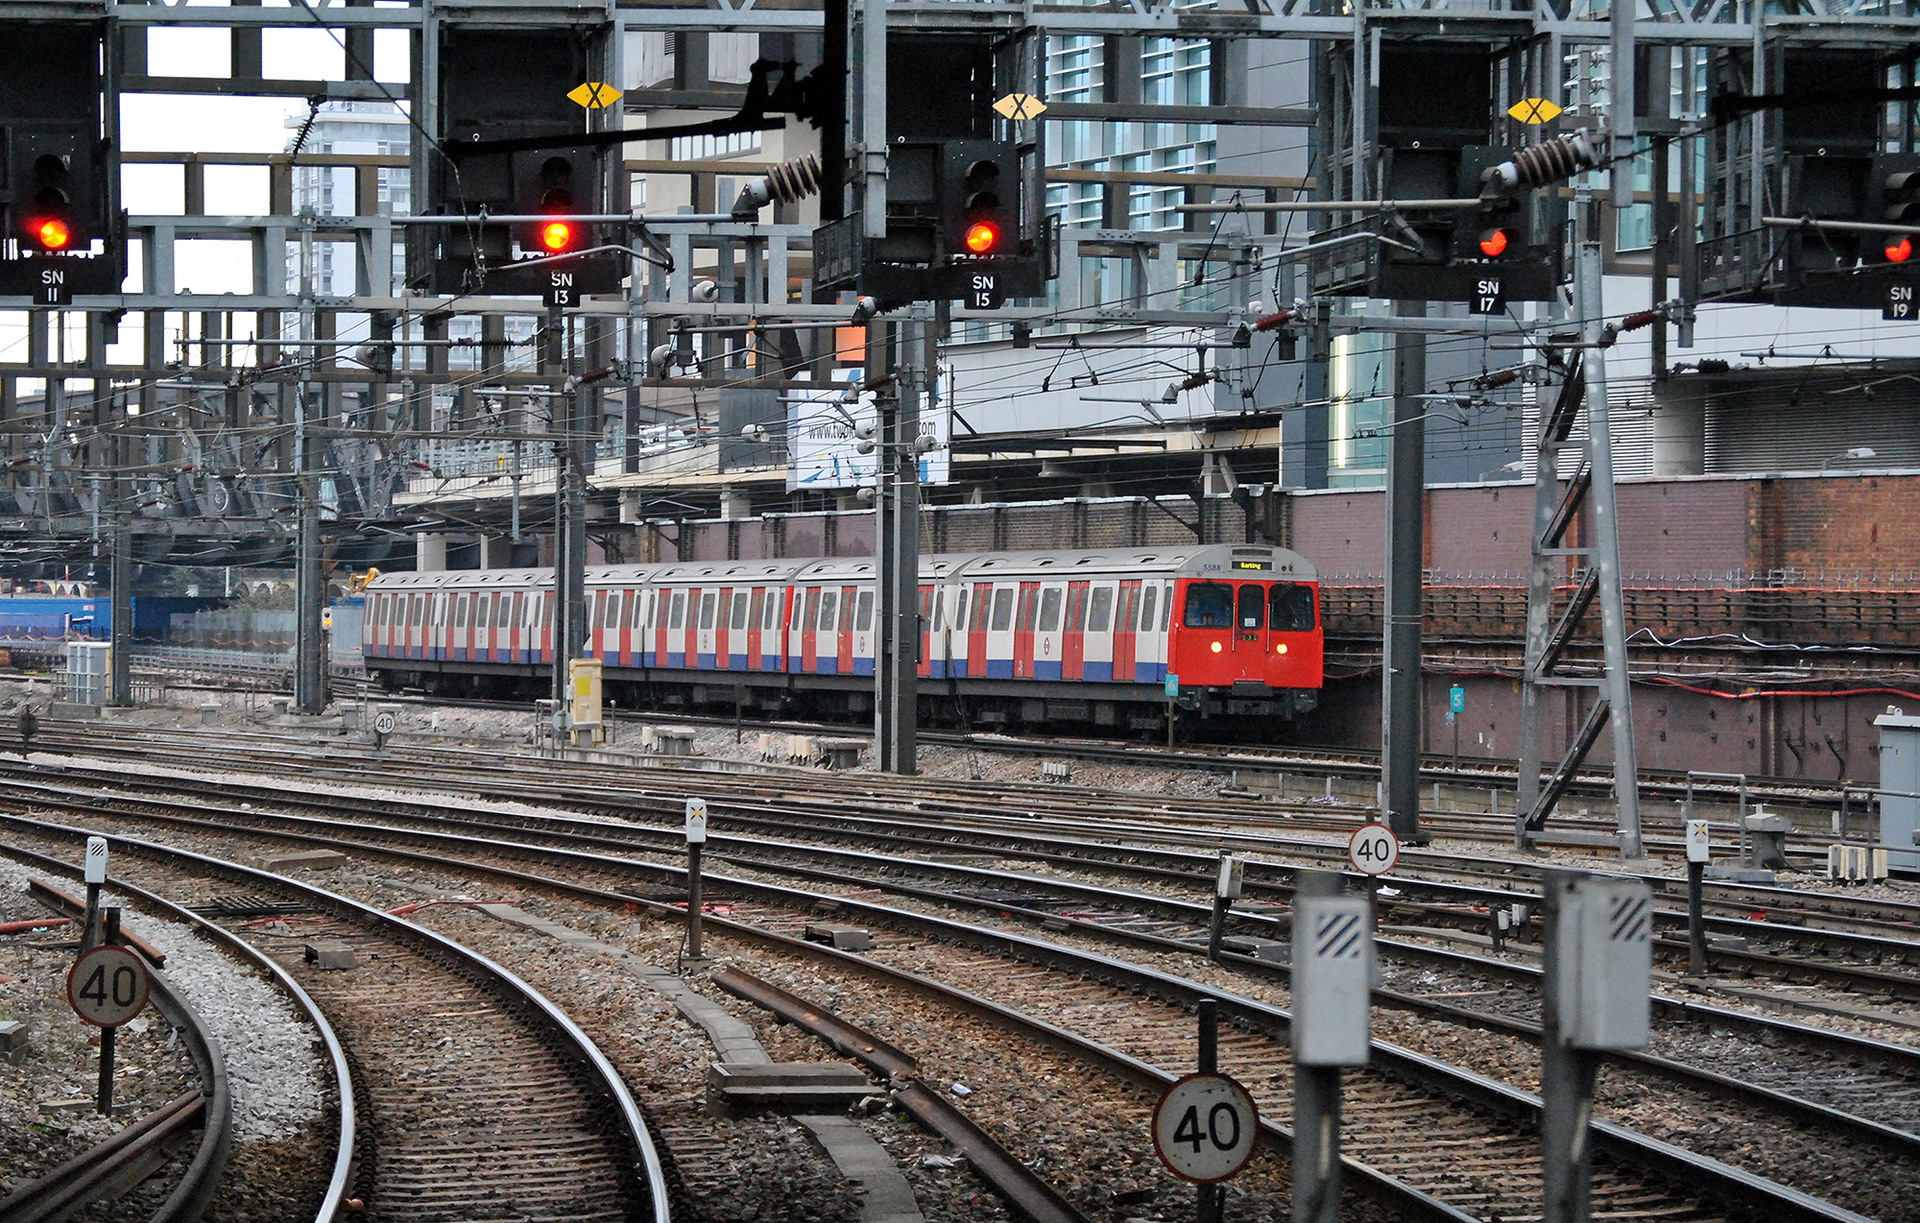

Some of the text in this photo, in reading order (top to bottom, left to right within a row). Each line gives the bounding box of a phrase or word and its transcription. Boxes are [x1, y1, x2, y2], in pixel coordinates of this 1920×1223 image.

[41, 270, 64, 284] SN
[551, 272, 573, 287] SN
[972, 276, 994, 290] SN
[48, 287, 58, 302] 11
[1477, 281, 1499, 295] SN
[1890, 287, 1912, 300] SN
[554, 290, 569, 304] 13
[976, 292, 990, 306] 15
[1480, 297, 1495, 312] 17
[1893, 303, 1908, 317] 19
[1203, 563, 1221, 571] 5588
[1240, 561, 1262, 570] Barking
[1168, 679, 1176, 691] 6
[1453, 694, 1461, 706] 5
[377, 718, 393, 729] 40
[1357, 838, 1389, 861] 40
[79, 964, 136, 1007] 40
[1173, 1102, 1240, 1153] 40
